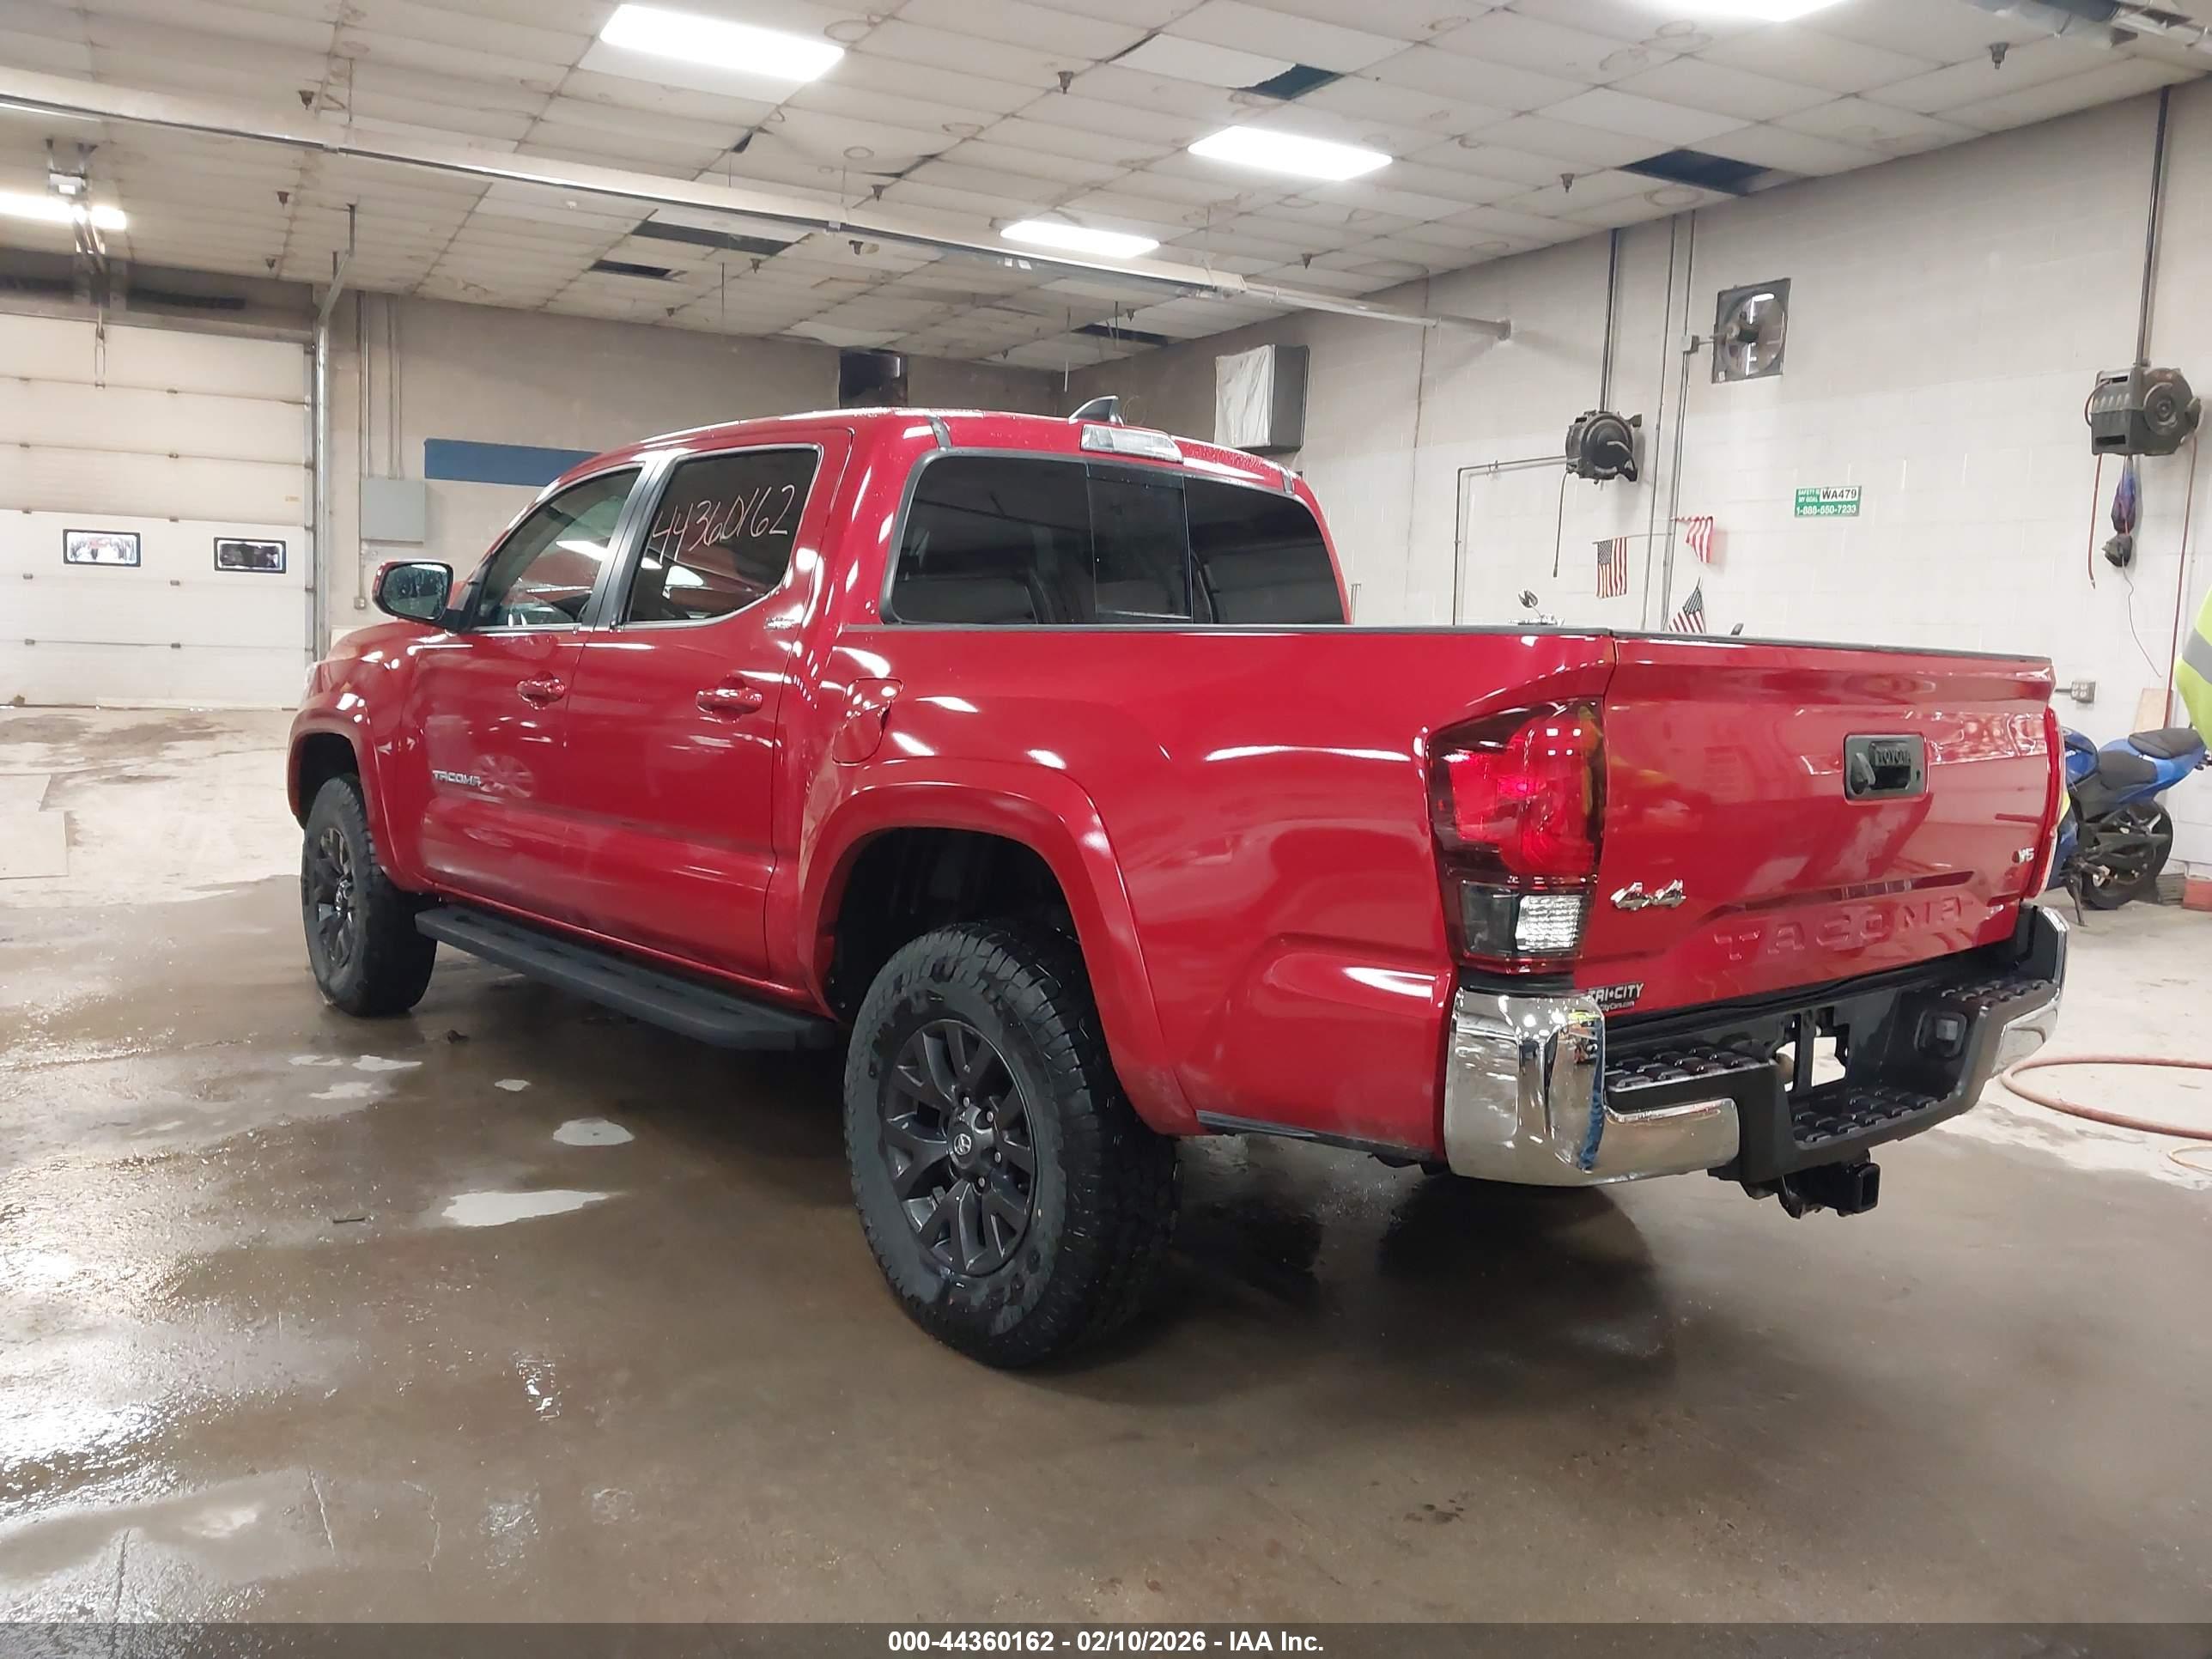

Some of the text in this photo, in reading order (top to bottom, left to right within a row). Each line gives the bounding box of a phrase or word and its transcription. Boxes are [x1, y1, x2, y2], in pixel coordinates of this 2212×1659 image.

[1821, 488, 1857, 500] WA479
[652, 483, 795, 565] 44360162
[432, 769, 483, 787] TACOMA
[1712, 896, 1962, 962] TACOMA
